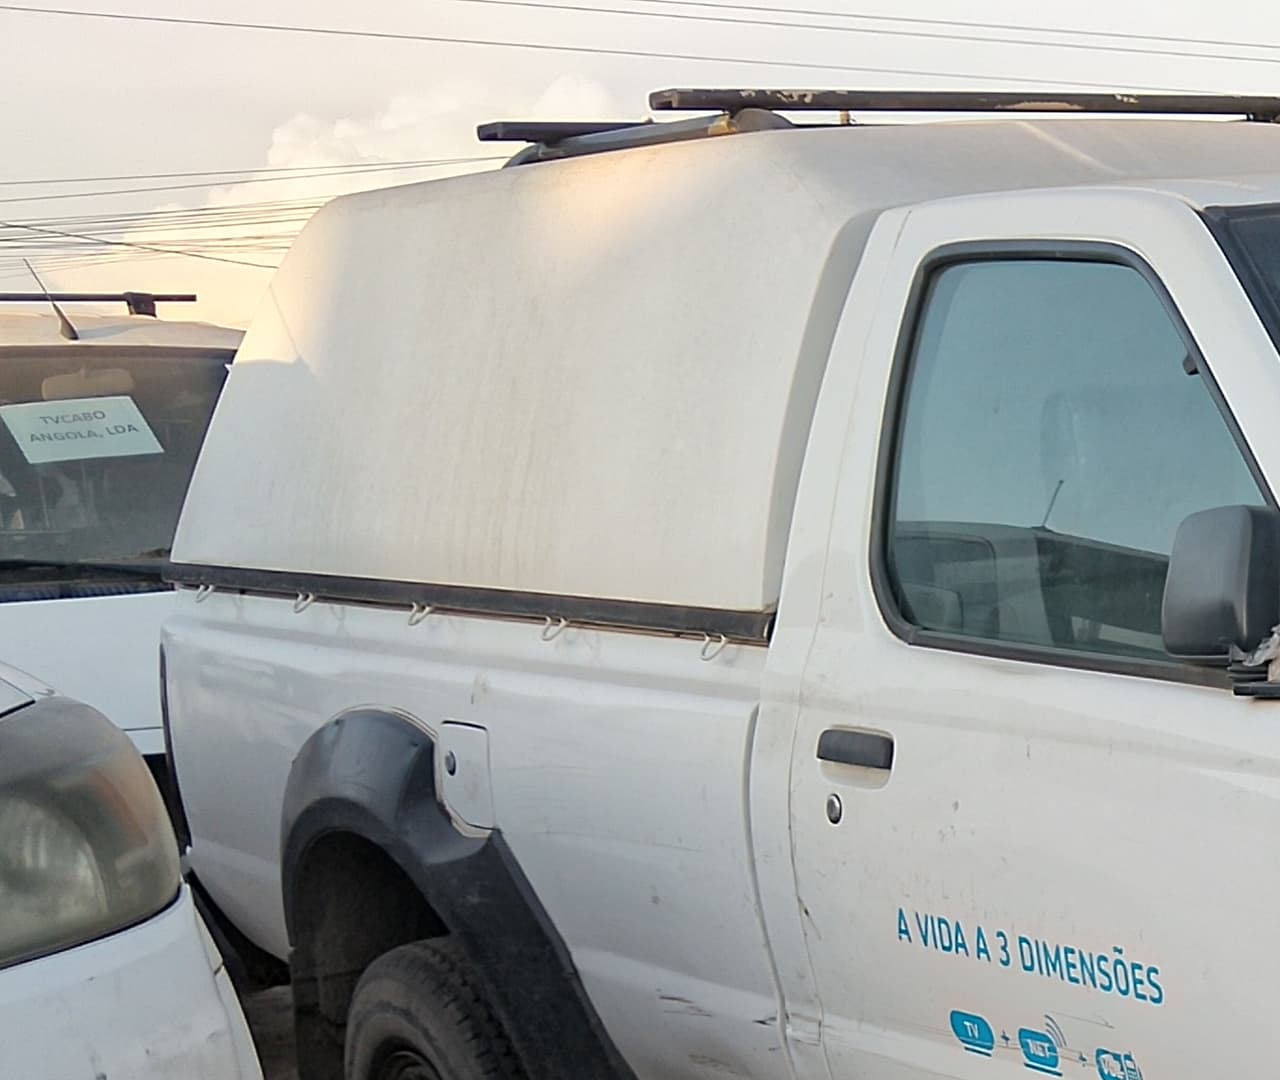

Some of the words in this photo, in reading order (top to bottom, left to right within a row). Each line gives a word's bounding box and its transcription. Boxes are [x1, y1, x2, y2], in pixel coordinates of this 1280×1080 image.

[40, 410, 106, 425] TVCABO
[105, 424, 139, 436] LDA
[898, 907, 912, 944] A
[915, 911, 969, 957] VIDA
[976, 926, 991, 963] A
[996, 930, 1011, 967] 3
[1018, 935, 1164, 1005] DIMENSÕES
[963, 1021, 979, 1039] TV
